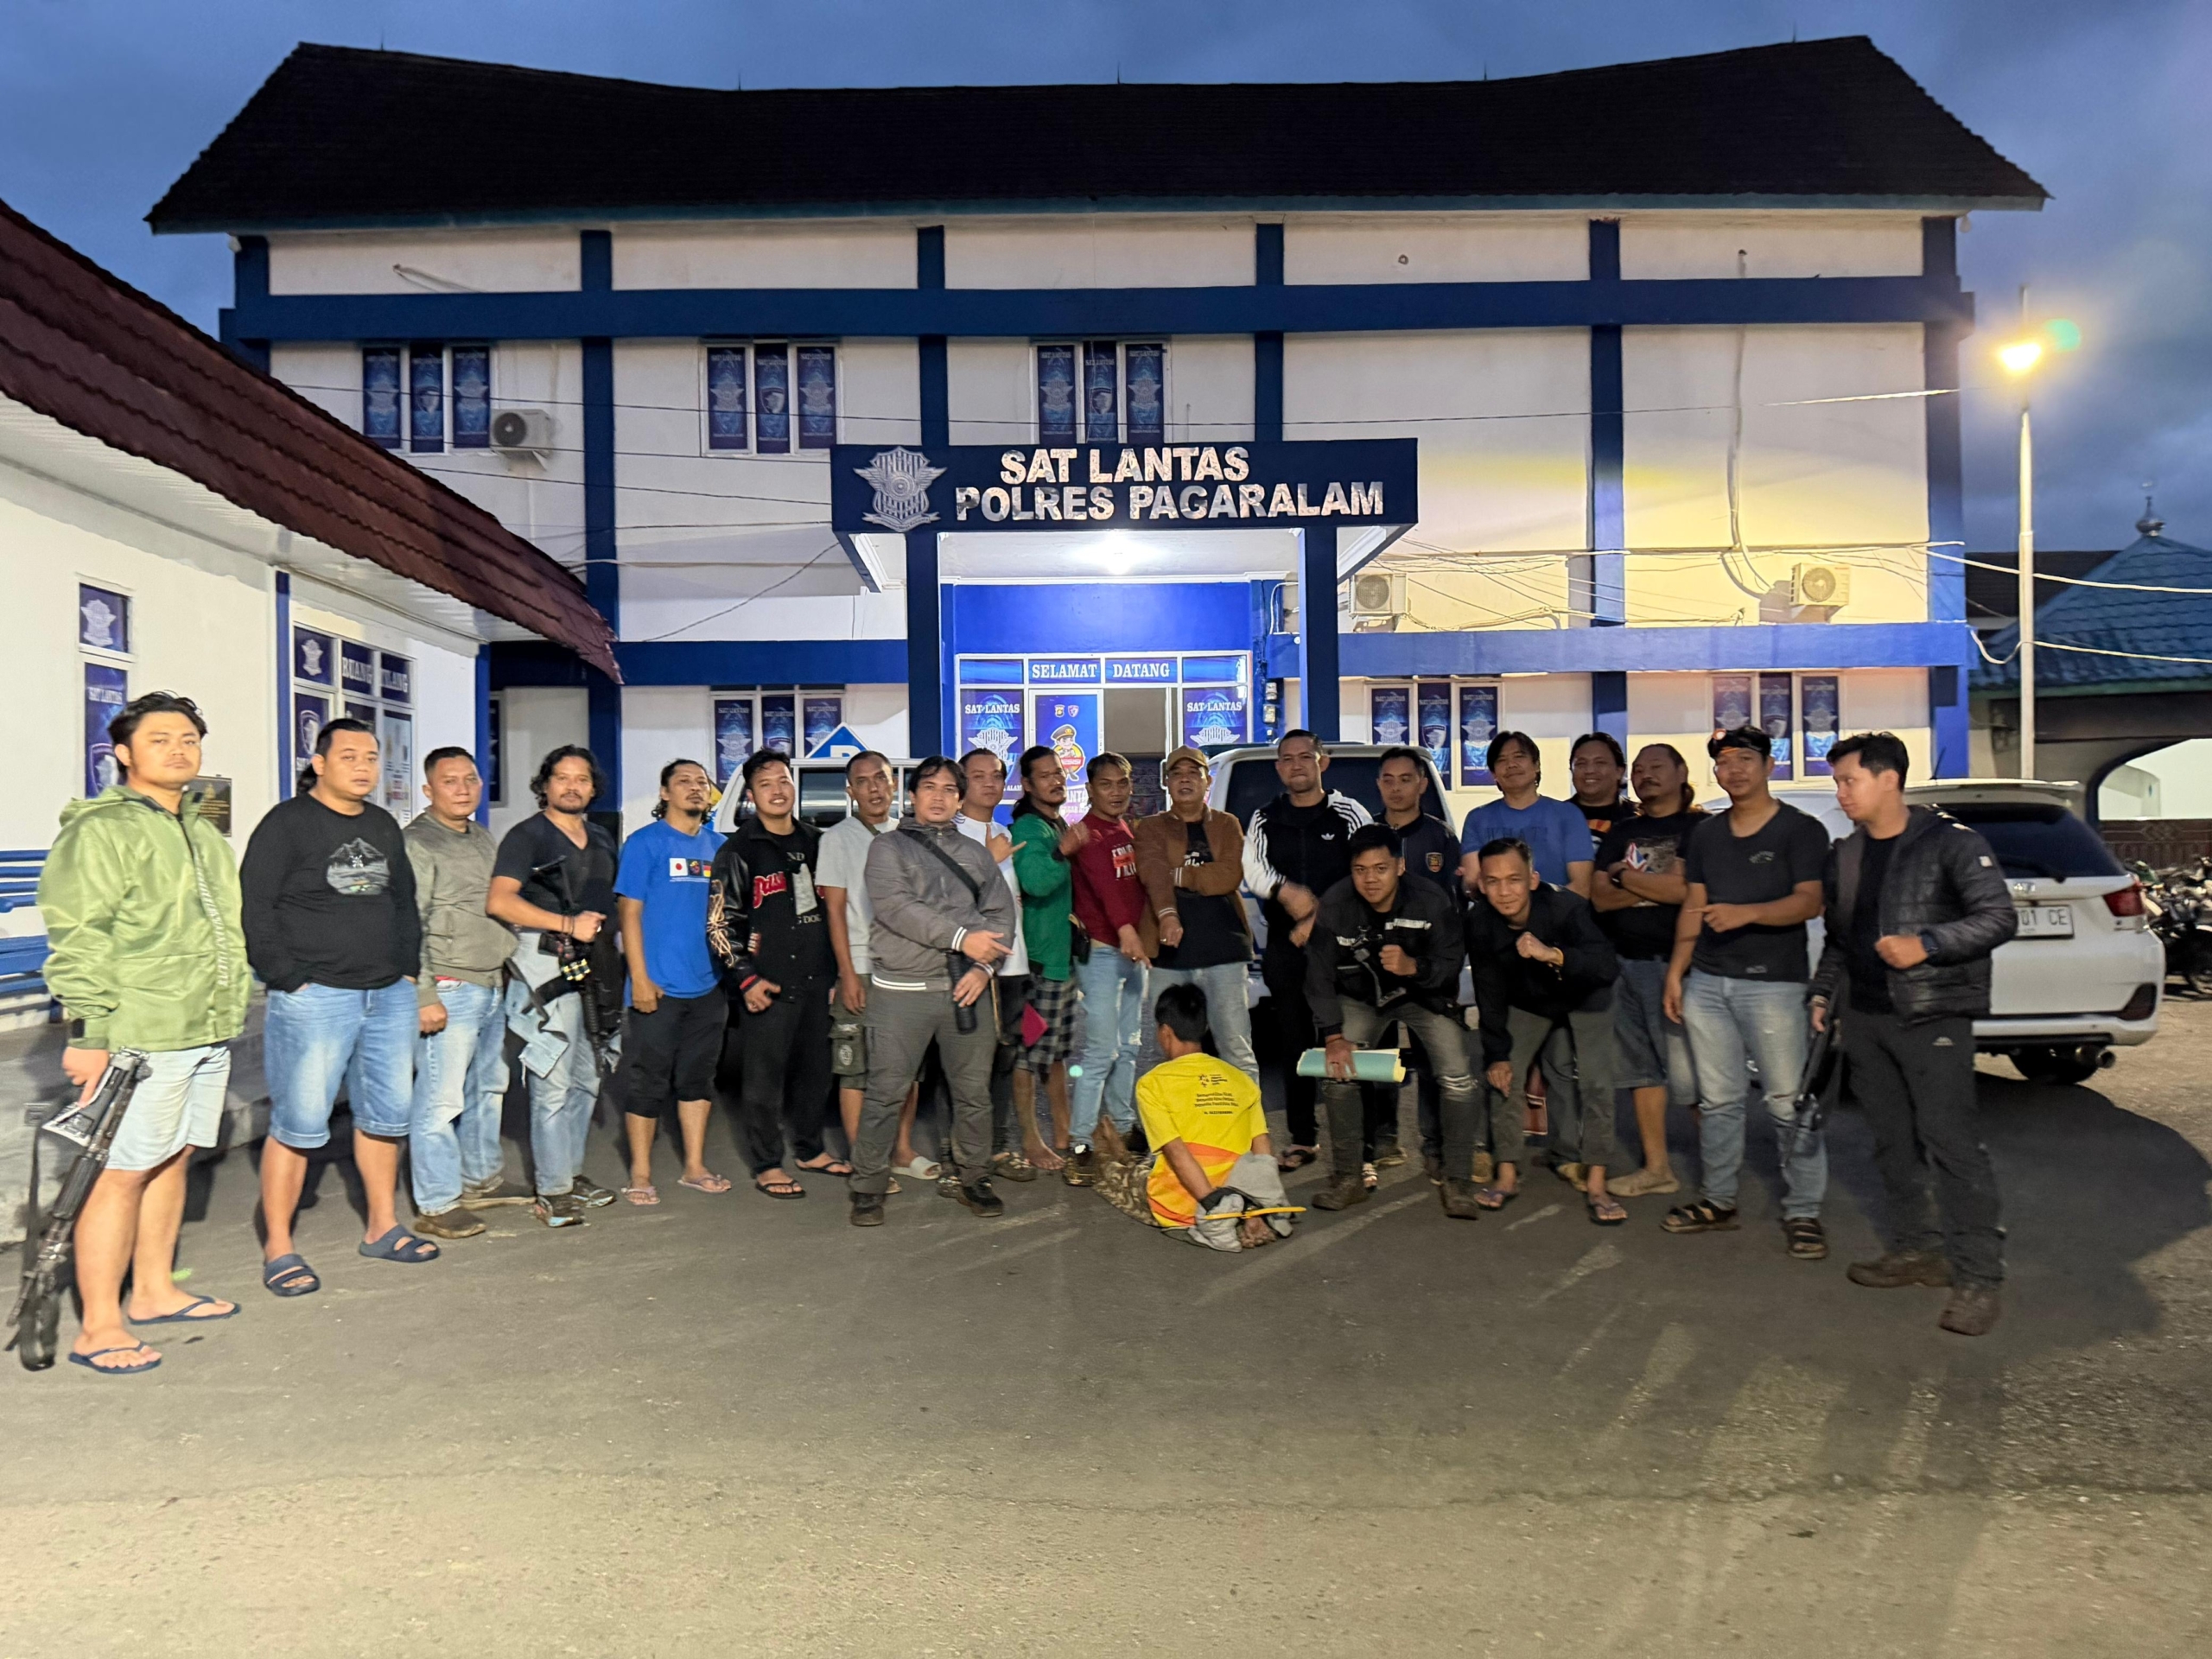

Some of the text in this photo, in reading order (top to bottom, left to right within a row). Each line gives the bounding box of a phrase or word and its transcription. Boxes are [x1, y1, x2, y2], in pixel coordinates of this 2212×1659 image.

[1000, 447, 1249, 484] SAT LANTAS
[955, 481, 1383, 521] POLRES PAGARALAM
[1032, 663, 1170, 678] SELAMAT DATANG
[965, 703, 1020, 714] SAT LANTAS
[1187, 701, 1243, 712] SAT LANTAS
[2049, 908, 2069, 925] CE
